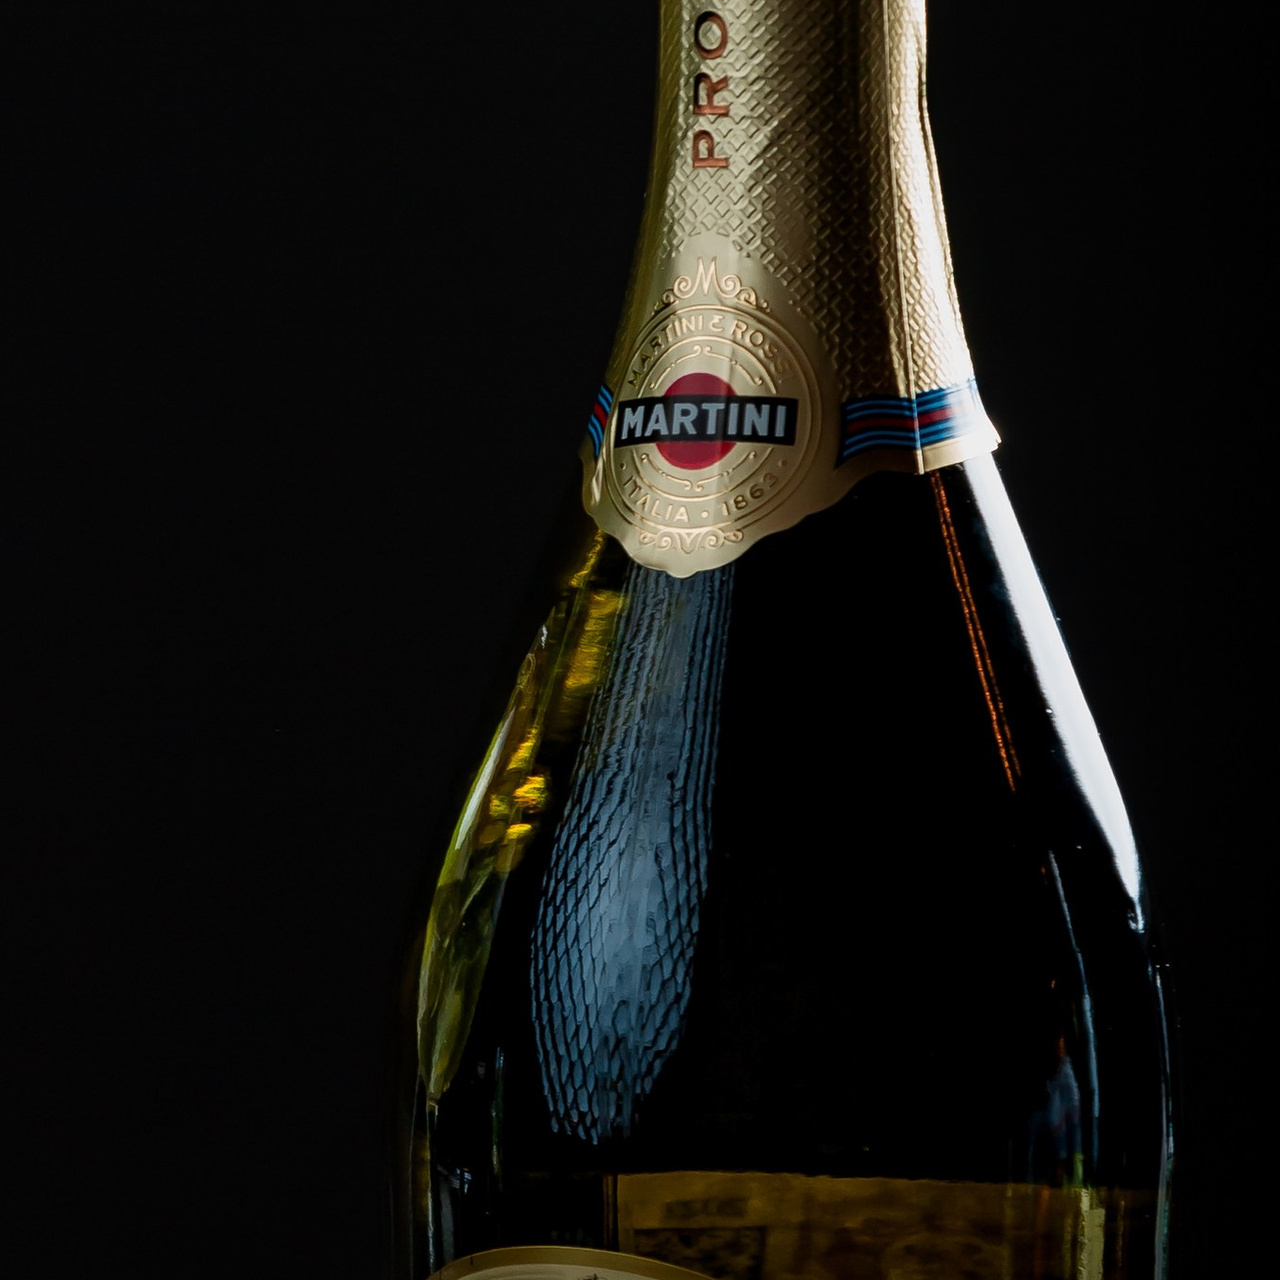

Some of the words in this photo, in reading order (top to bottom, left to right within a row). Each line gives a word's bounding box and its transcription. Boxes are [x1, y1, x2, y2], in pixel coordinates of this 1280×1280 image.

[629, 315, 704, 387] MARTINI
[620, 402, 787, 440] MARTINI
[622, 474, 691, 522] ITALIA
[719, 472, 780, 517] 1863
